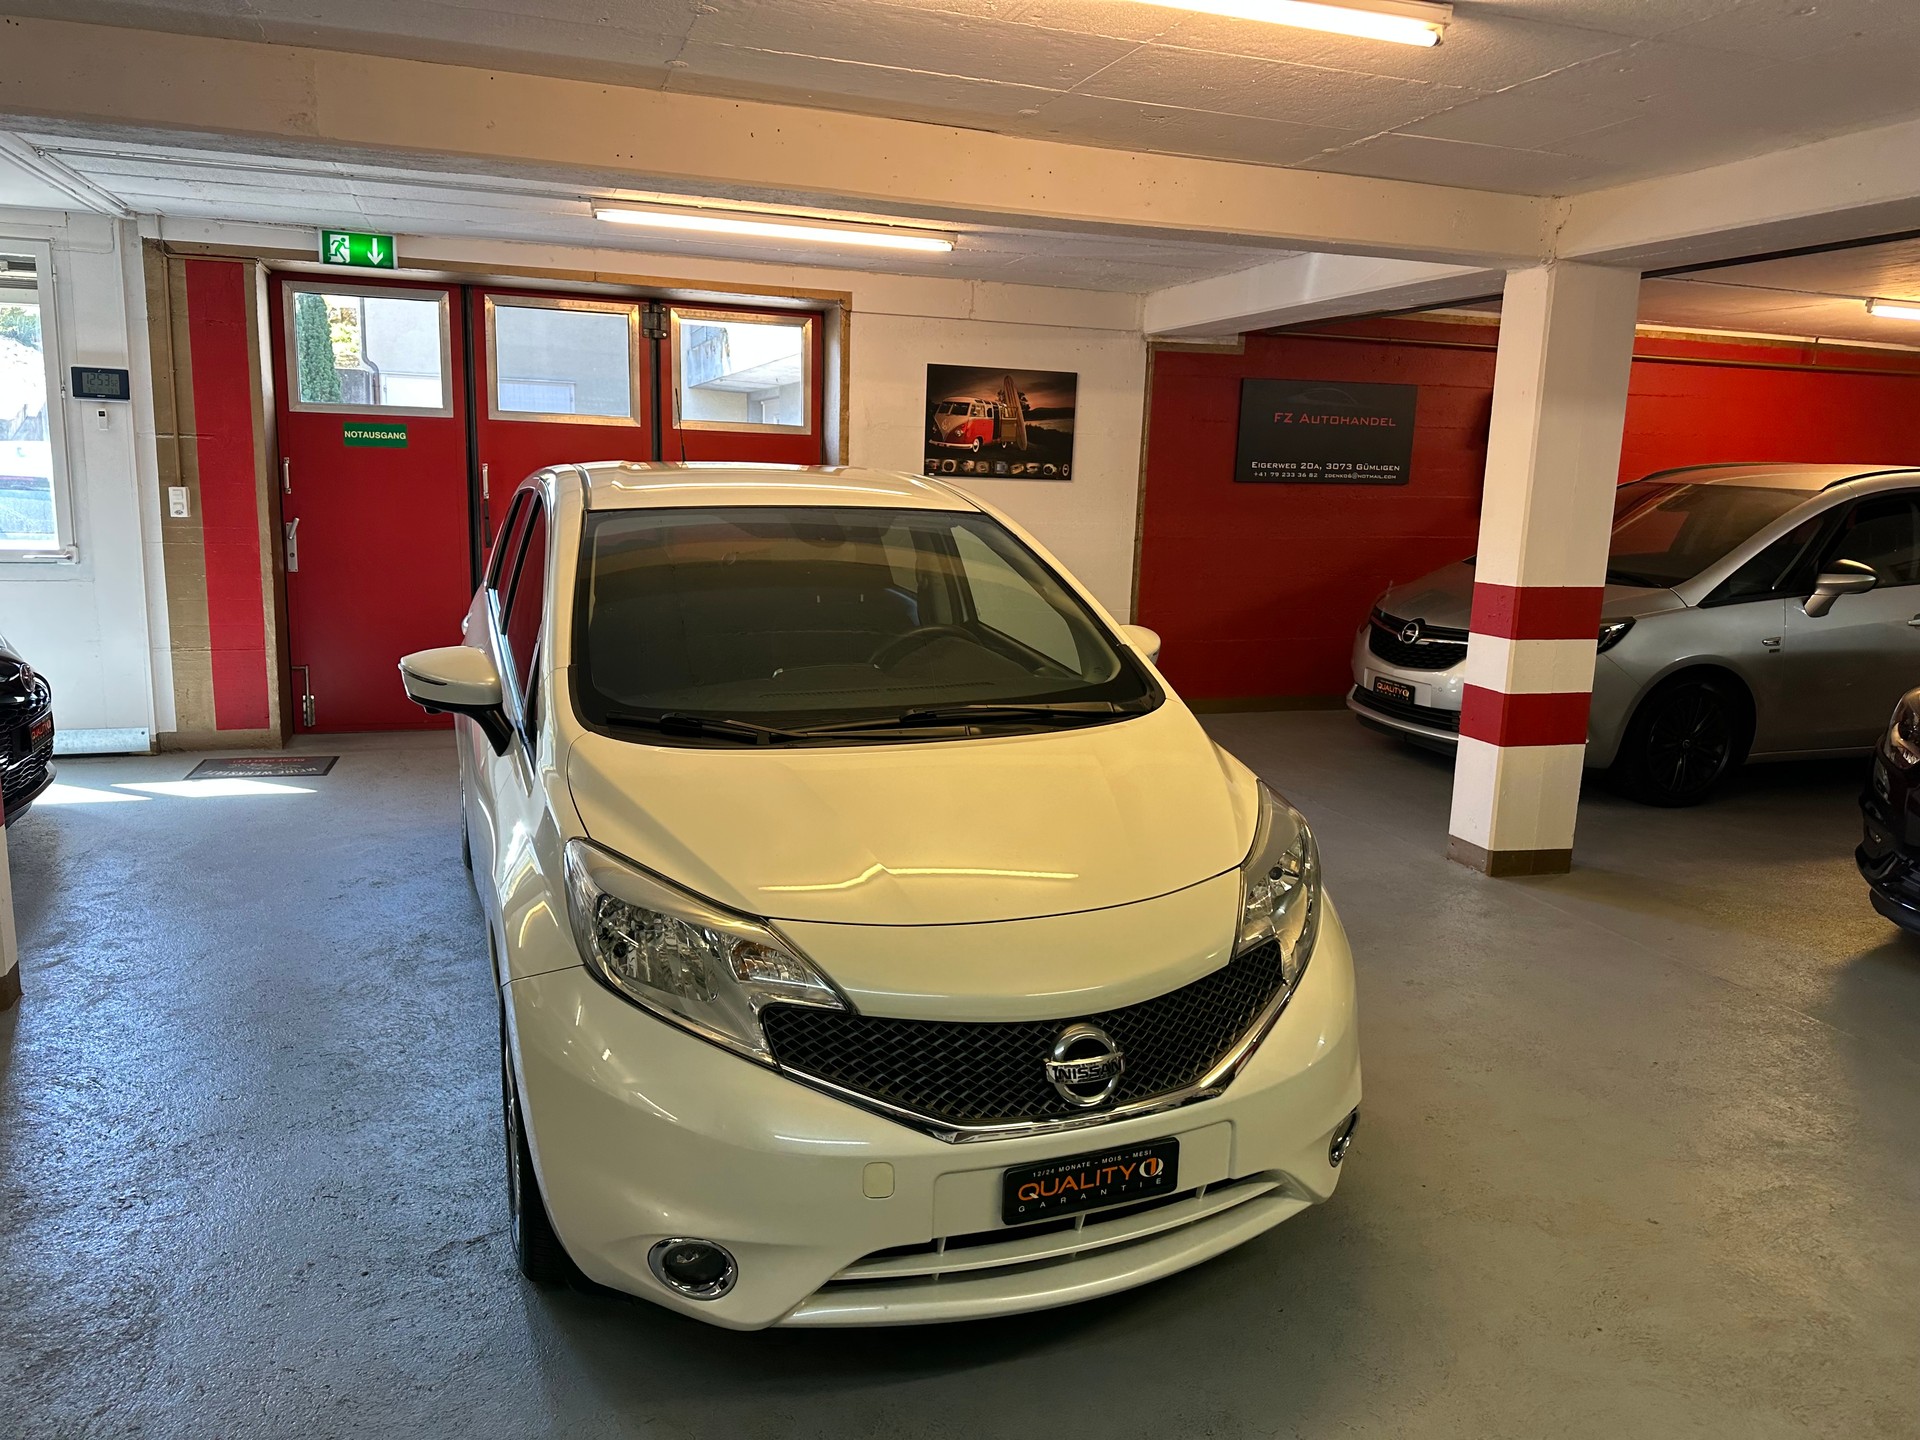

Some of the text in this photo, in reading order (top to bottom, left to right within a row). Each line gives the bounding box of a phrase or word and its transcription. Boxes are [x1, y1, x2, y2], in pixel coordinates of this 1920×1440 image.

[1274, 412, 1294, 423] FZ
[344, 430, 407, 440] NOTAUSGANG
[1325, 462, 1353, 470] 3073
[1058, 1061, 1121, 1080] NISSAN
[1032, 1149, 1152, 1178] 12/24 MONATE MOIS MESI
[1017, 1163, 1137, 1201] QUALITY
[1018, 1177, 1162, 1213] GARANTIE
